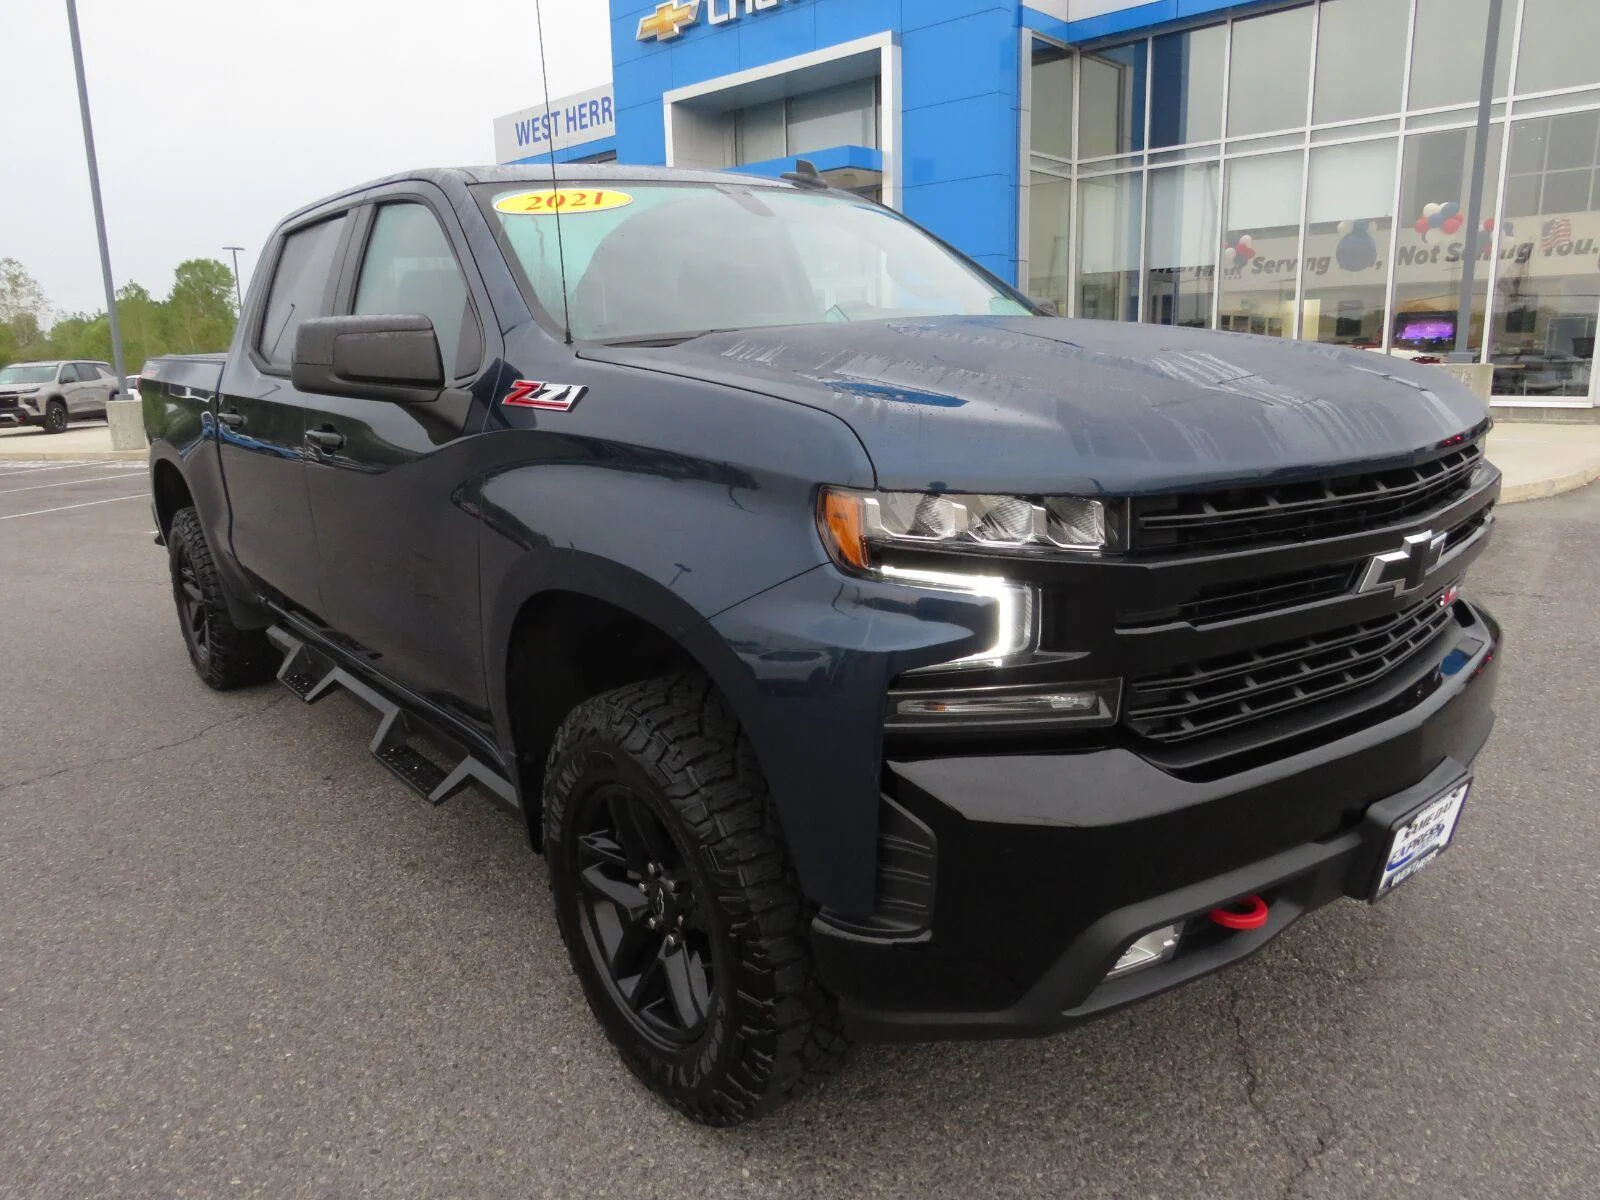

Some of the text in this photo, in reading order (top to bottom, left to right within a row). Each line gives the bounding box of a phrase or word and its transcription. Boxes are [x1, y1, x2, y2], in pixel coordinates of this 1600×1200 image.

[515, 97, 613, 147] WEST HERR
[524, 191, 604, 211] 2021
[1251, 256, 1331, 275] Servng
[1398, 245, 1441, 266] Not
[502, 380, 588, 412] Z71
